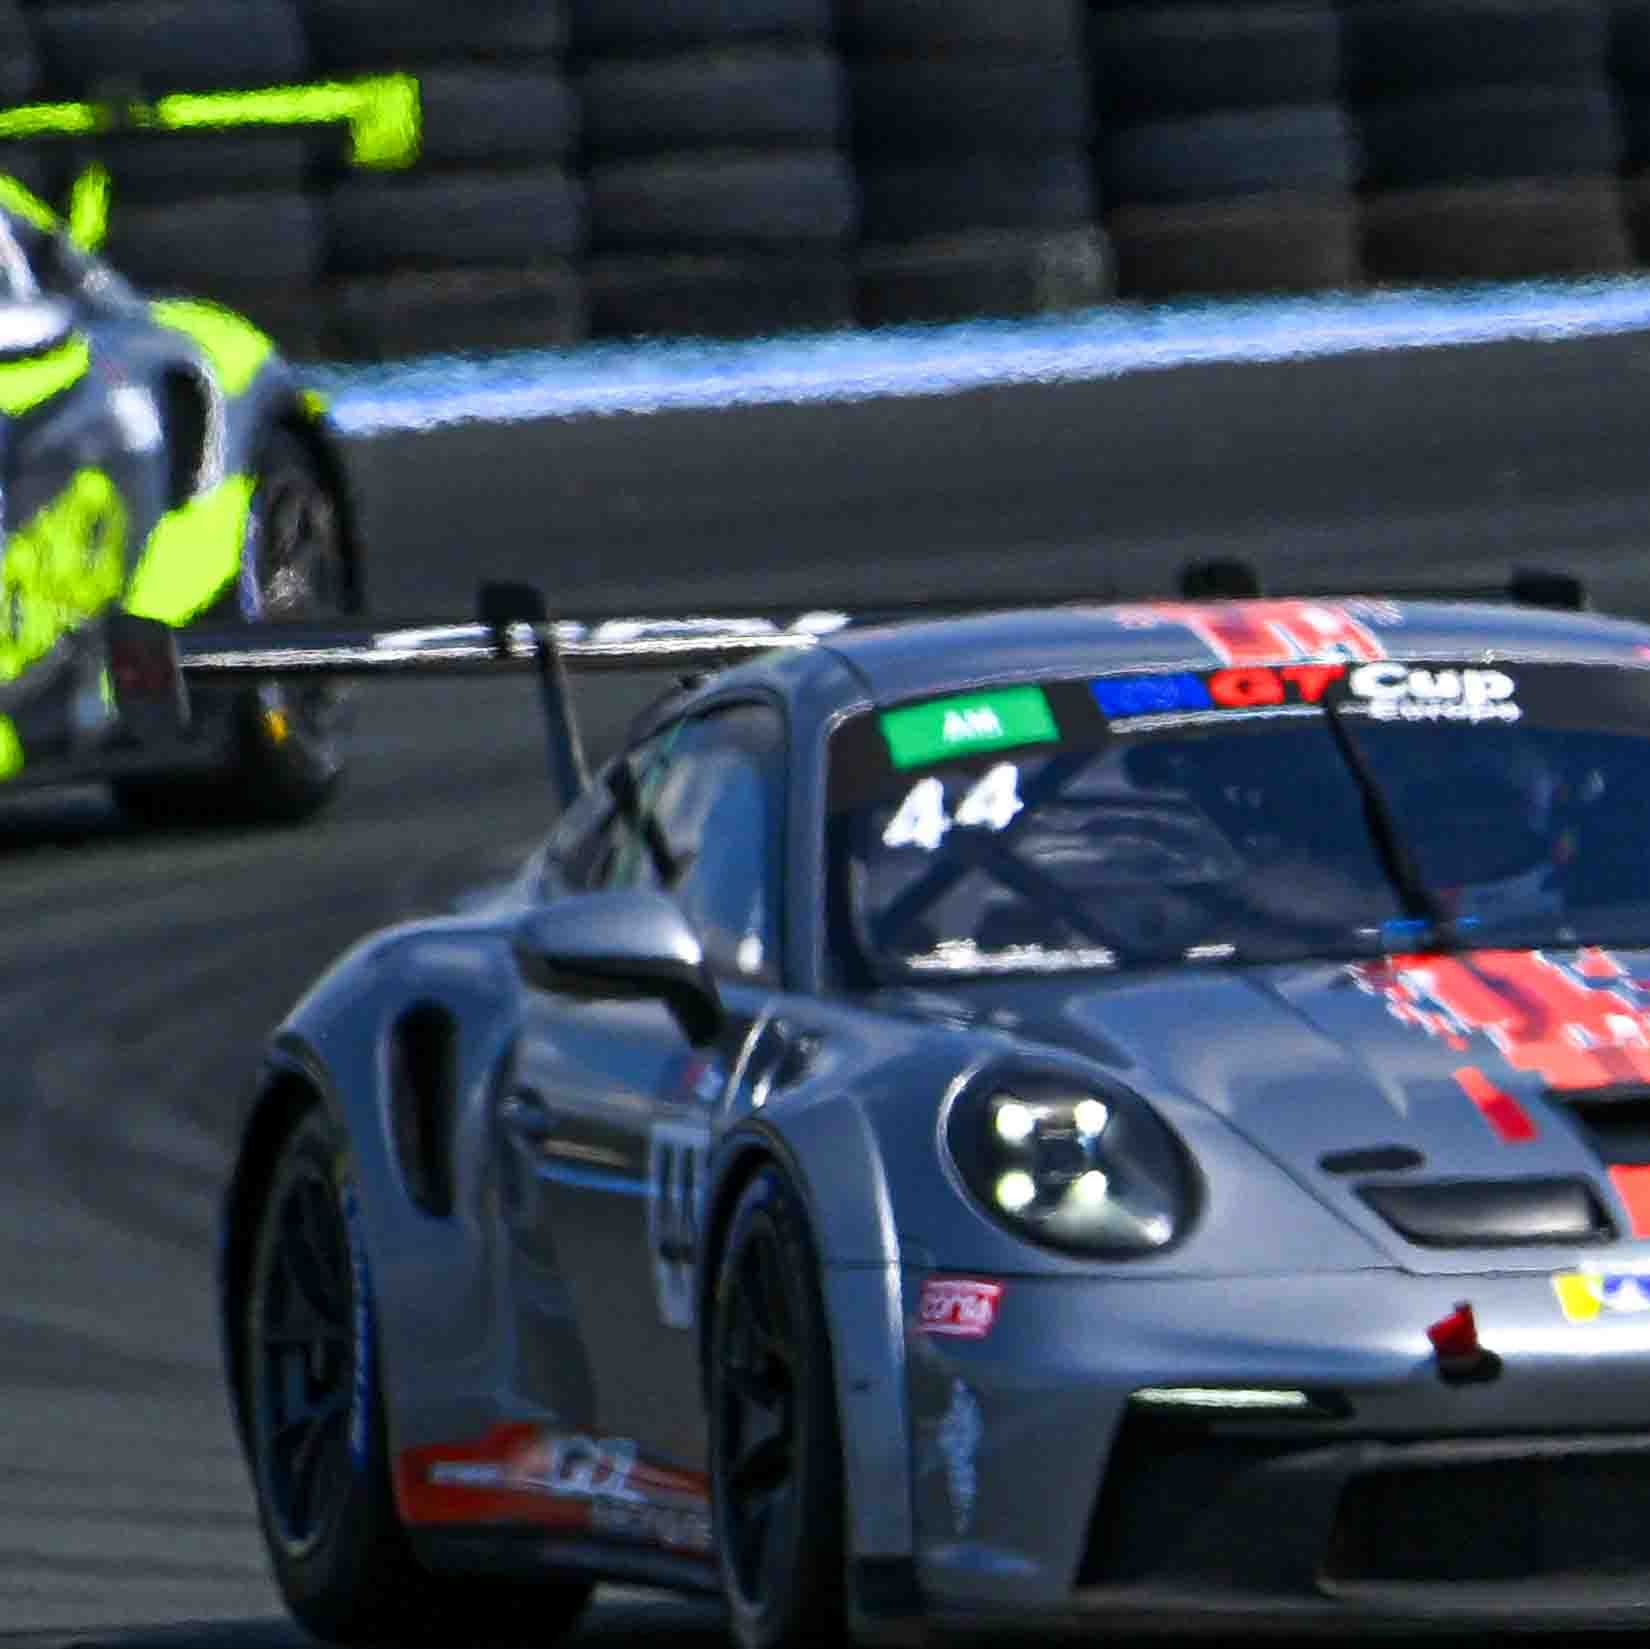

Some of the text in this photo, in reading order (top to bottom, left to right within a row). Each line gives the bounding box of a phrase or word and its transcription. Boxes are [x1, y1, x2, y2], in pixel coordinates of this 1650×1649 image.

[1350, 661, 1515, 710] Cup
[944, 705, 1003, 743] AM
[882, 762, 1024, 848] 44
